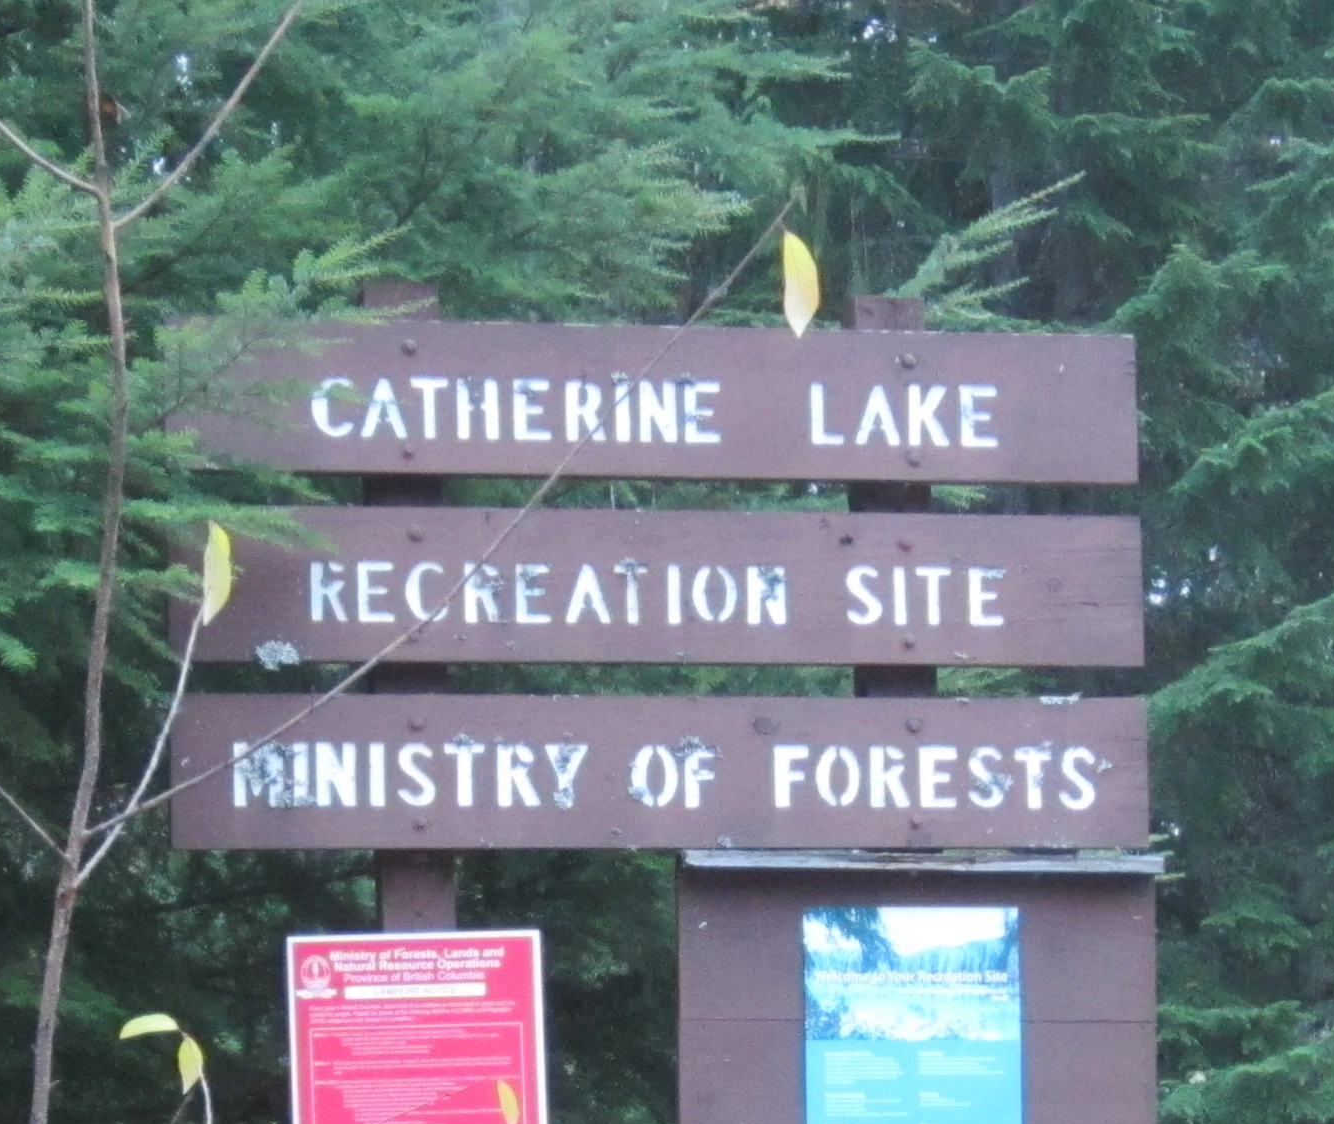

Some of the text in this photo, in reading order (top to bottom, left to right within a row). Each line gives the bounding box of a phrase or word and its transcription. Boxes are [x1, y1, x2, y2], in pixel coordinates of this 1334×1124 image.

[310, 374, 1000, 448] CATHERINE LAKE
[309, 559, 1007, 627] RECREATION SITE
[232, 741, 1099, 813] MINISTRY OF FORESTS
[329, 950, 375, 962] Ministry
[379, 949, 392, 960] of
[444, 947, 480, 959] Lands
[482, 947, 504, 958] and
[334, 957, 501, 972] Natural Resource Operations
[343, 970, 485, 983] Province of British Columbia
[816, 970, 1008, 982] Welcome to Your Recreation Site
